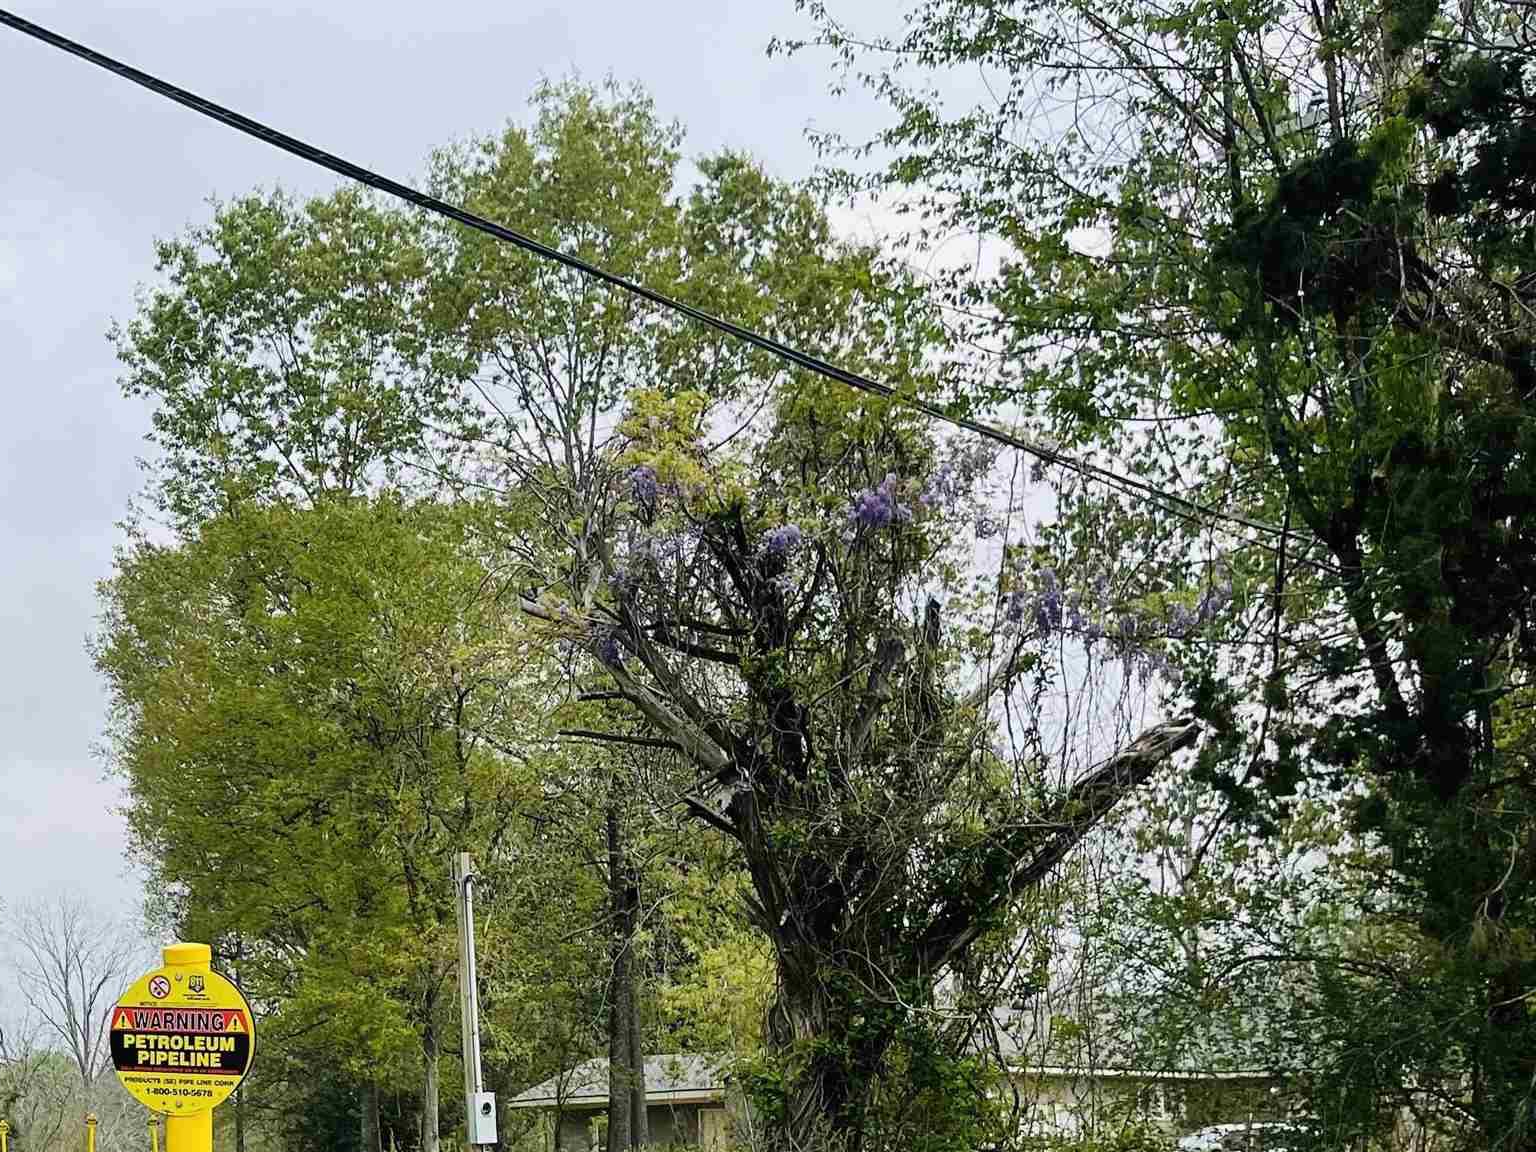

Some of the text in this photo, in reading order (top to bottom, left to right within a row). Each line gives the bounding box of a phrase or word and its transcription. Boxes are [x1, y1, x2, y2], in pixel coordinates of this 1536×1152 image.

[133, 1010, 224, 1031] WARNING
[123, 1034, 235, 1052] PETROLEUM
[137, 1051, 222, 1067] PIPELINE
